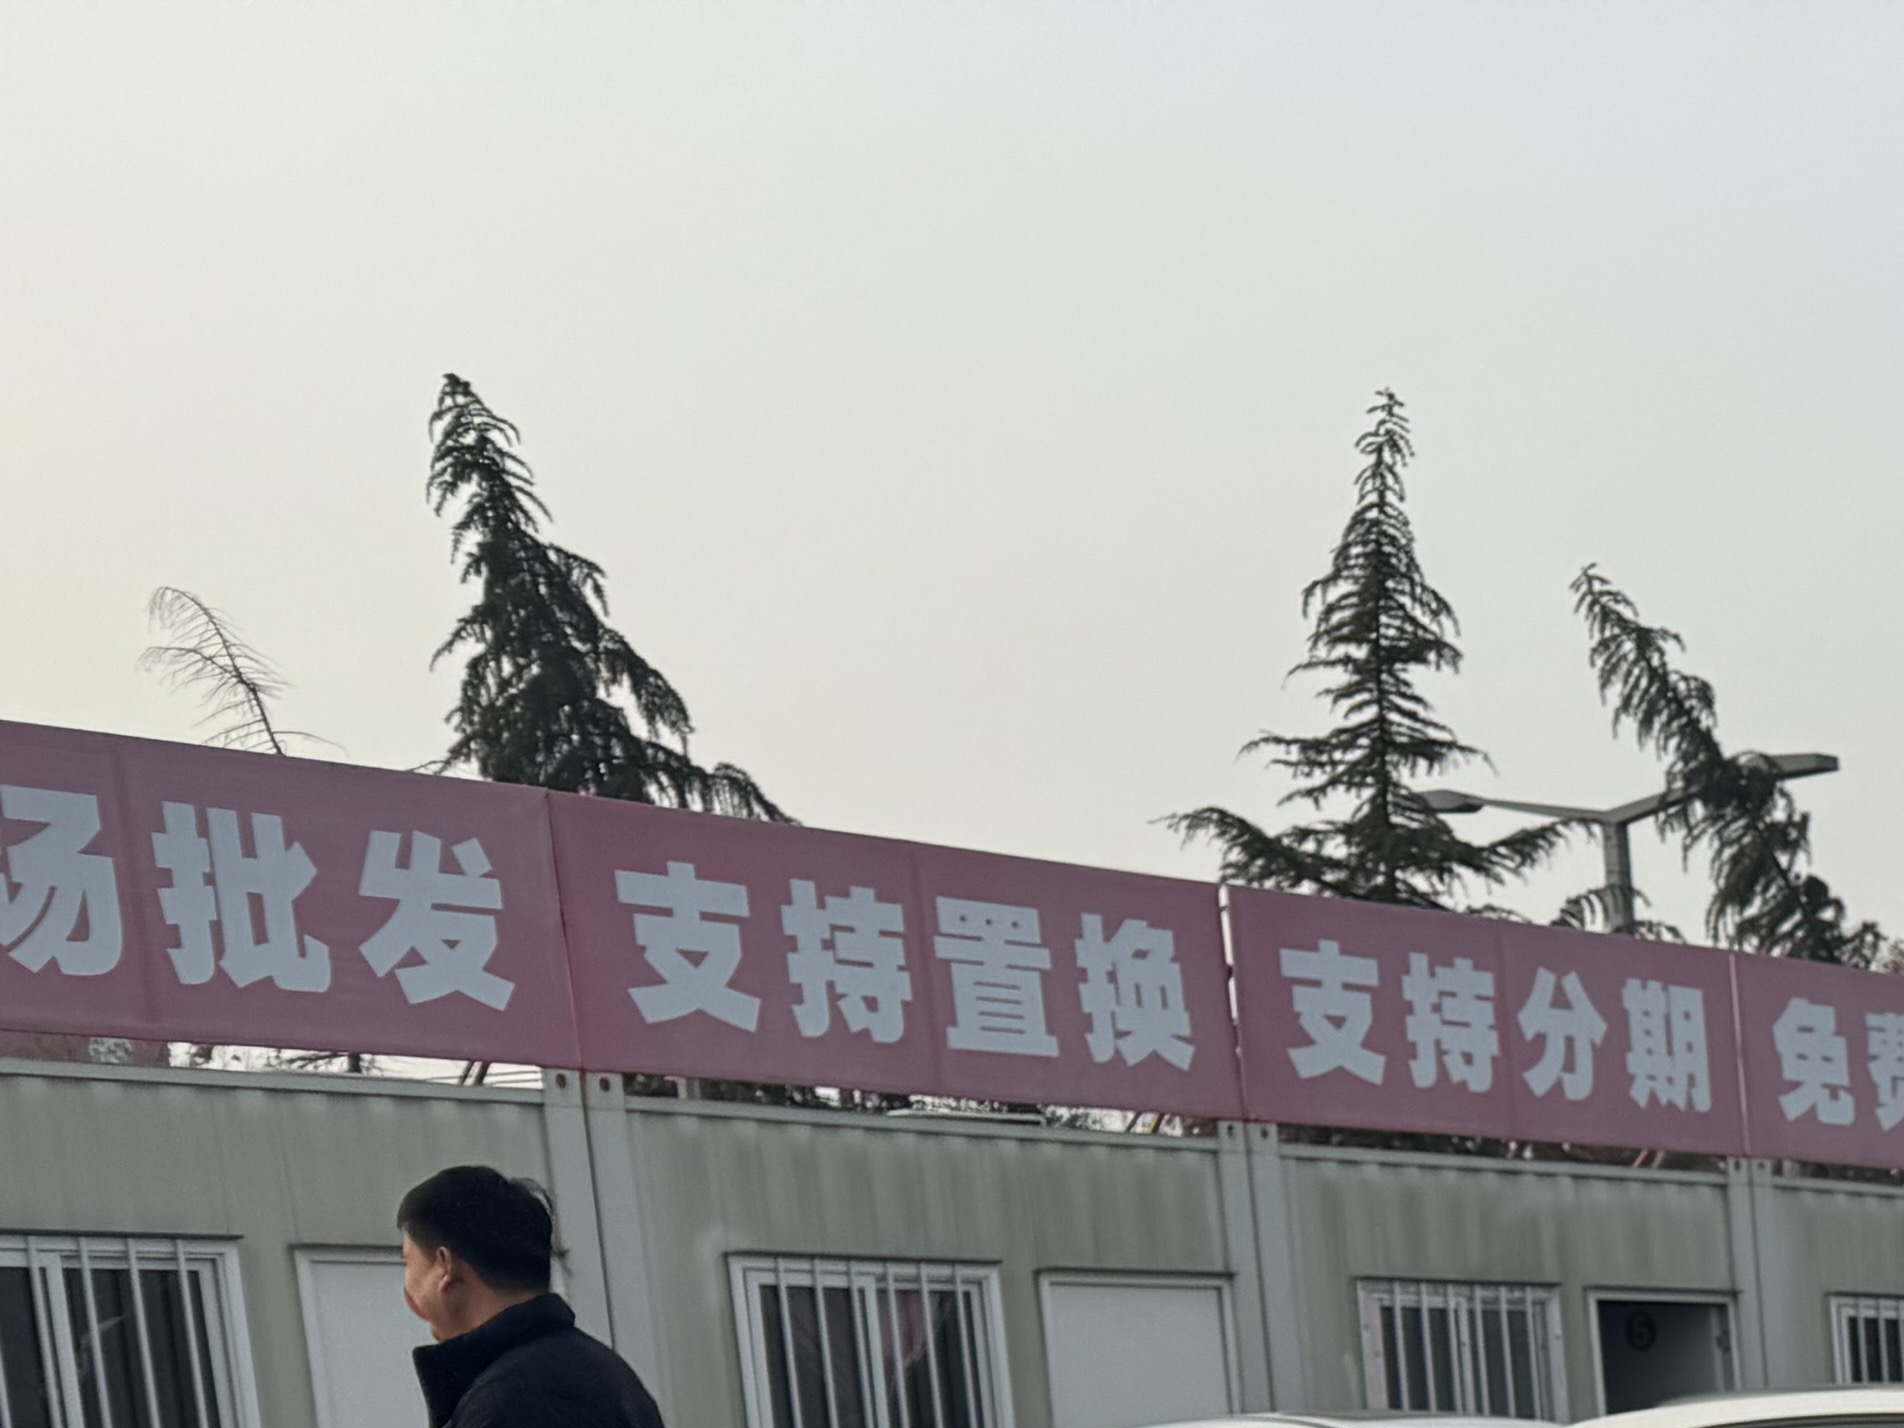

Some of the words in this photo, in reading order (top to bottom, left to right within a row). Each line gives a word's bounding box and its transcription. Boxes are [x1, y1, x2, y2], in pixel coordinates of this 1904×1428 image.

[613, 860, 1196, 1072] 支持置换
[1279, 939, 1712, 1114] 支持分期
